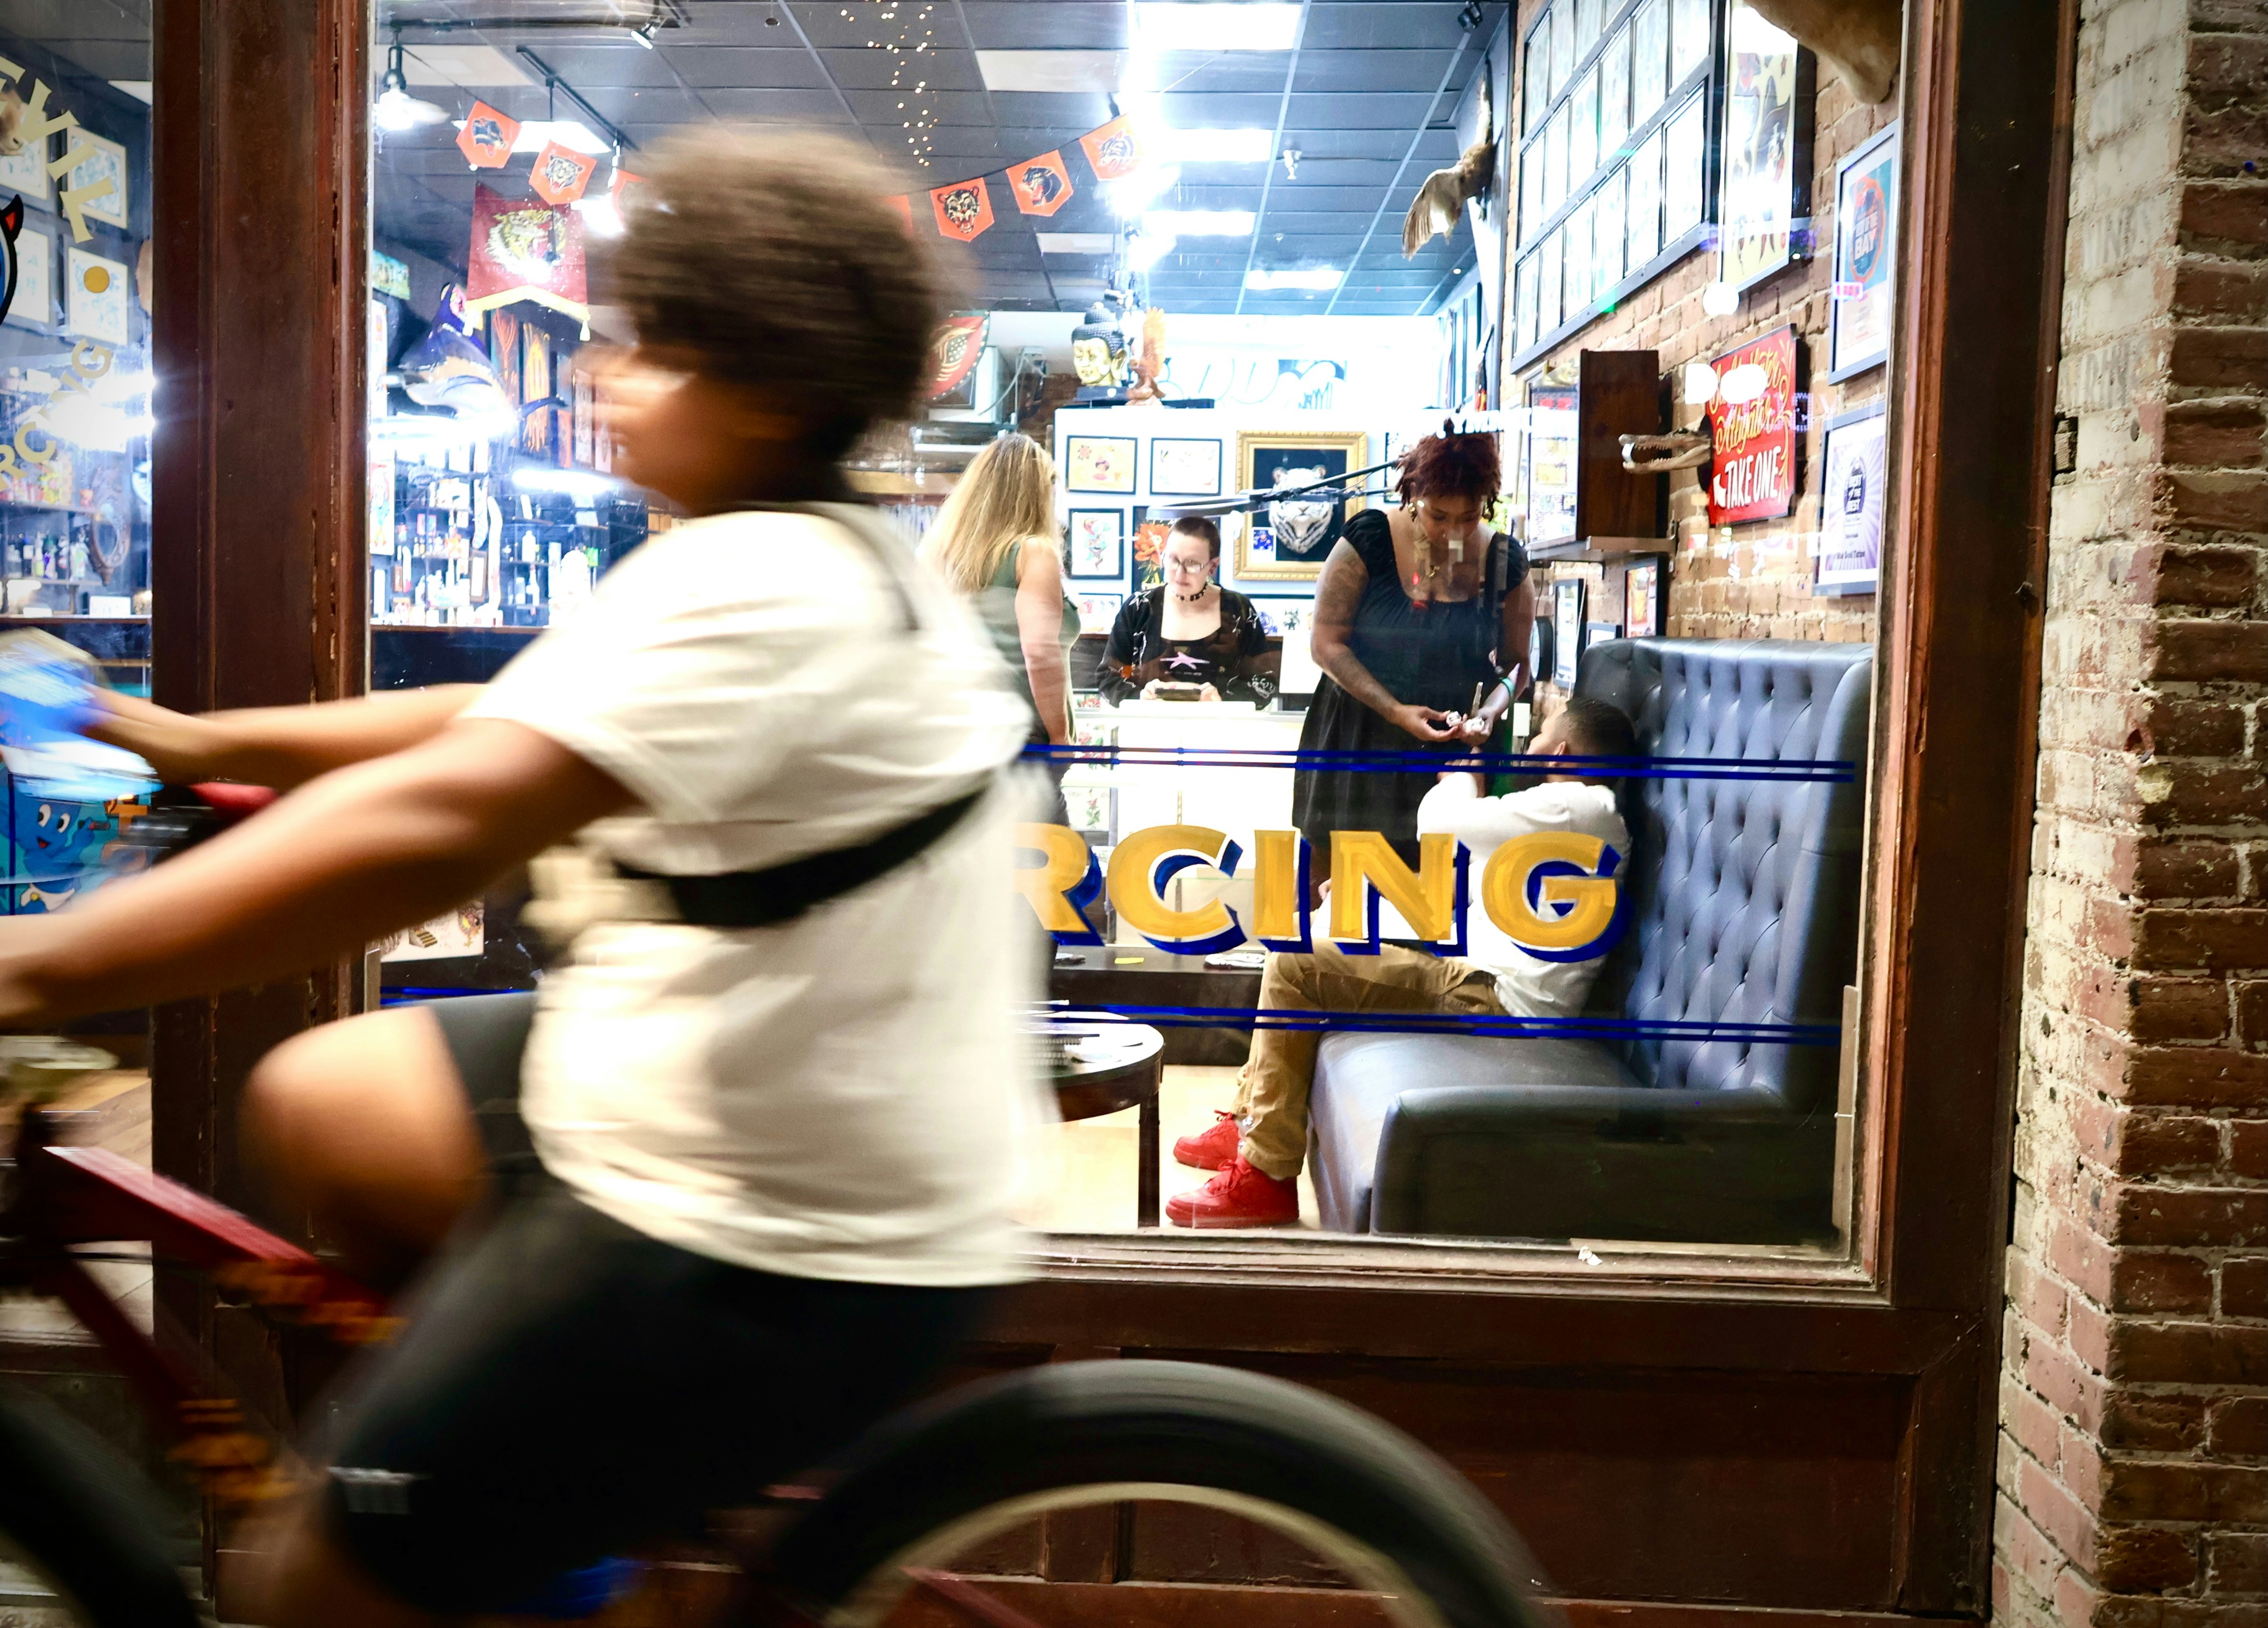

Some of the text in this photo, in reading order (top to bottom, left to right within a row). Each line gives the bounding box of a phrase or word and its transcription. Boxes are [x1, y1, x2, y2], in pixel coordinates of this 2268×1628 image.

[0, 338, 112, 491] RCNG
[1725, 446, 1781, 509] TAKE ONE
